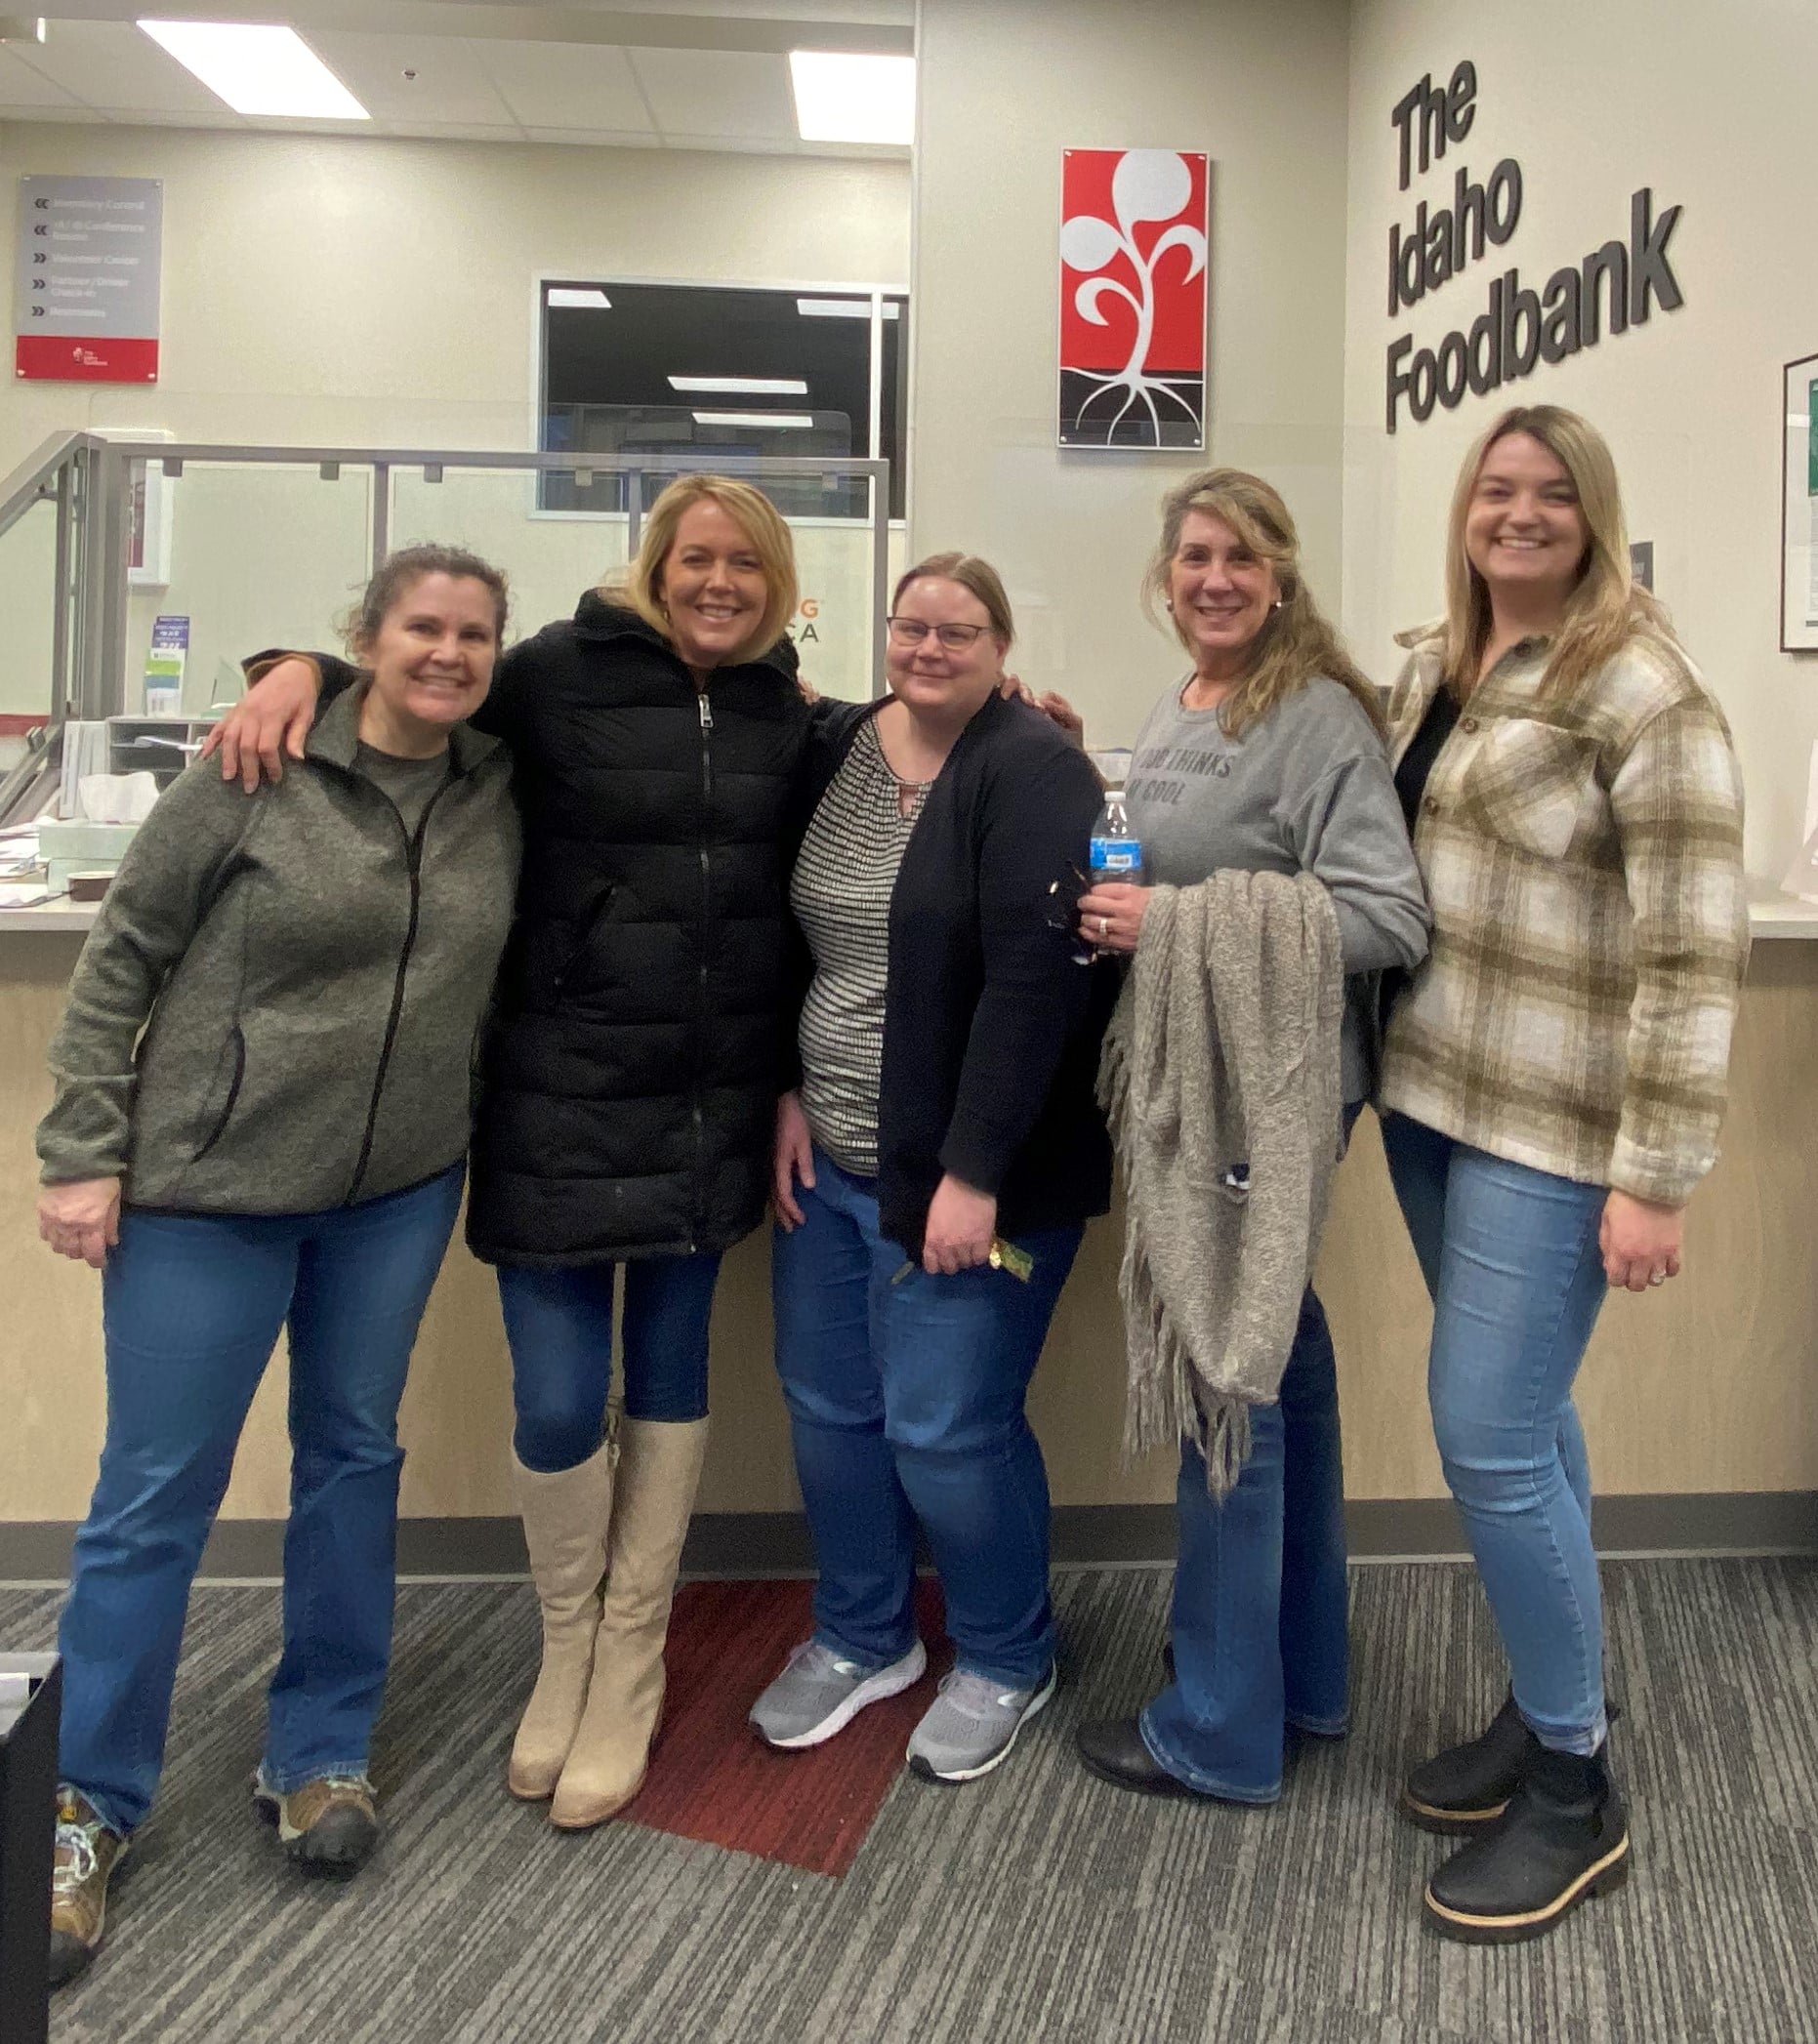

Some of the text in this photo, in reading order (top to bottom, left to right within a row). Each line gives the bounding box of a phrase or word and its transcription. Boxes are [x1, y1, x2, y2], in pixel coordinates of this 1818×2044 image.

[1391, 60, 1477, 191] The
[1387, 158, 1523, 317] Idaho
[1386, 187, 1684, 434] Foodbank
[1142, 780, 1185, 804] COOL
[1167, 749, 1236, 778] THINKS
